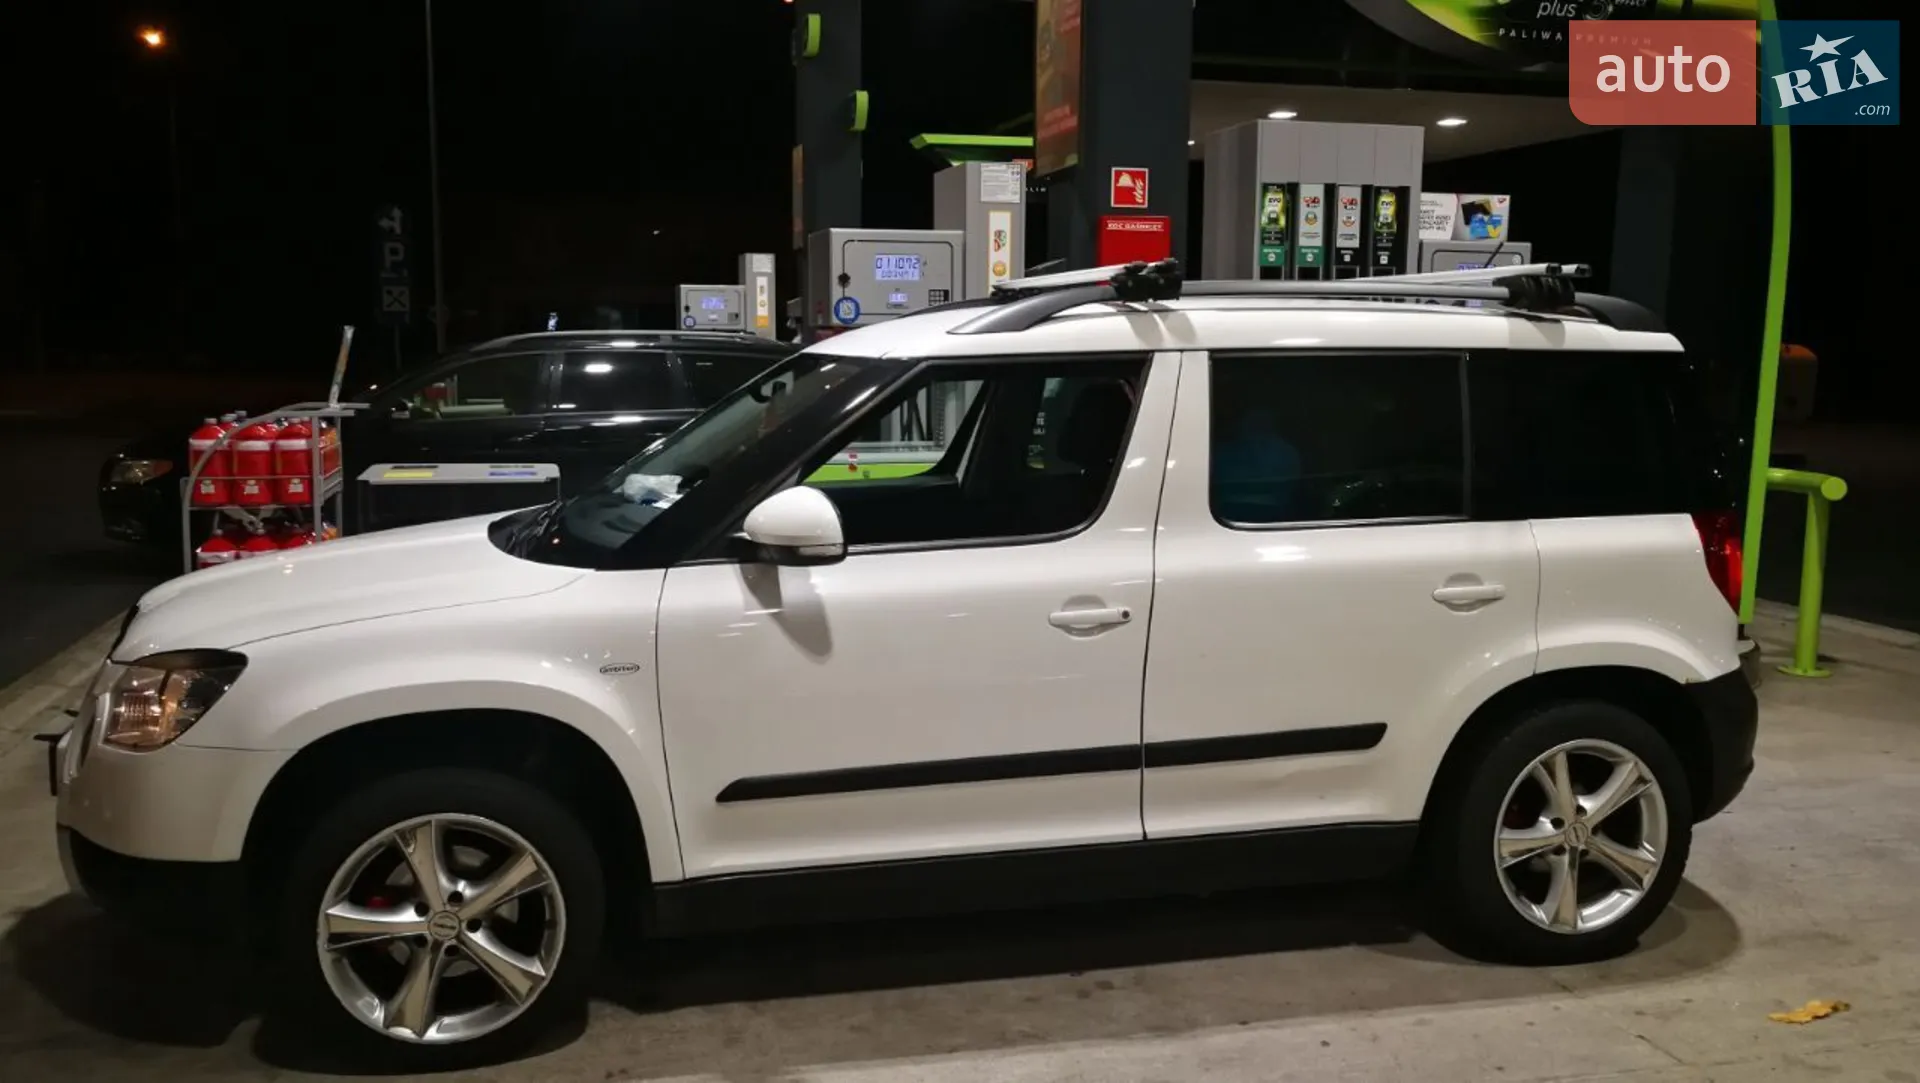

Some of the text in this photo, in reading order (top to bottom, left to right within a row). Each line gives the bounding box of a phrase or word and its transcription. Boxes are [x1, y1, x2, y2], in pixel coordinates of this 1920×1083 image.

[1536, 0, 1577, 18] plus
[1498, 28, 1563, 41] PALIWA
[384, 242, 405, 269] P
